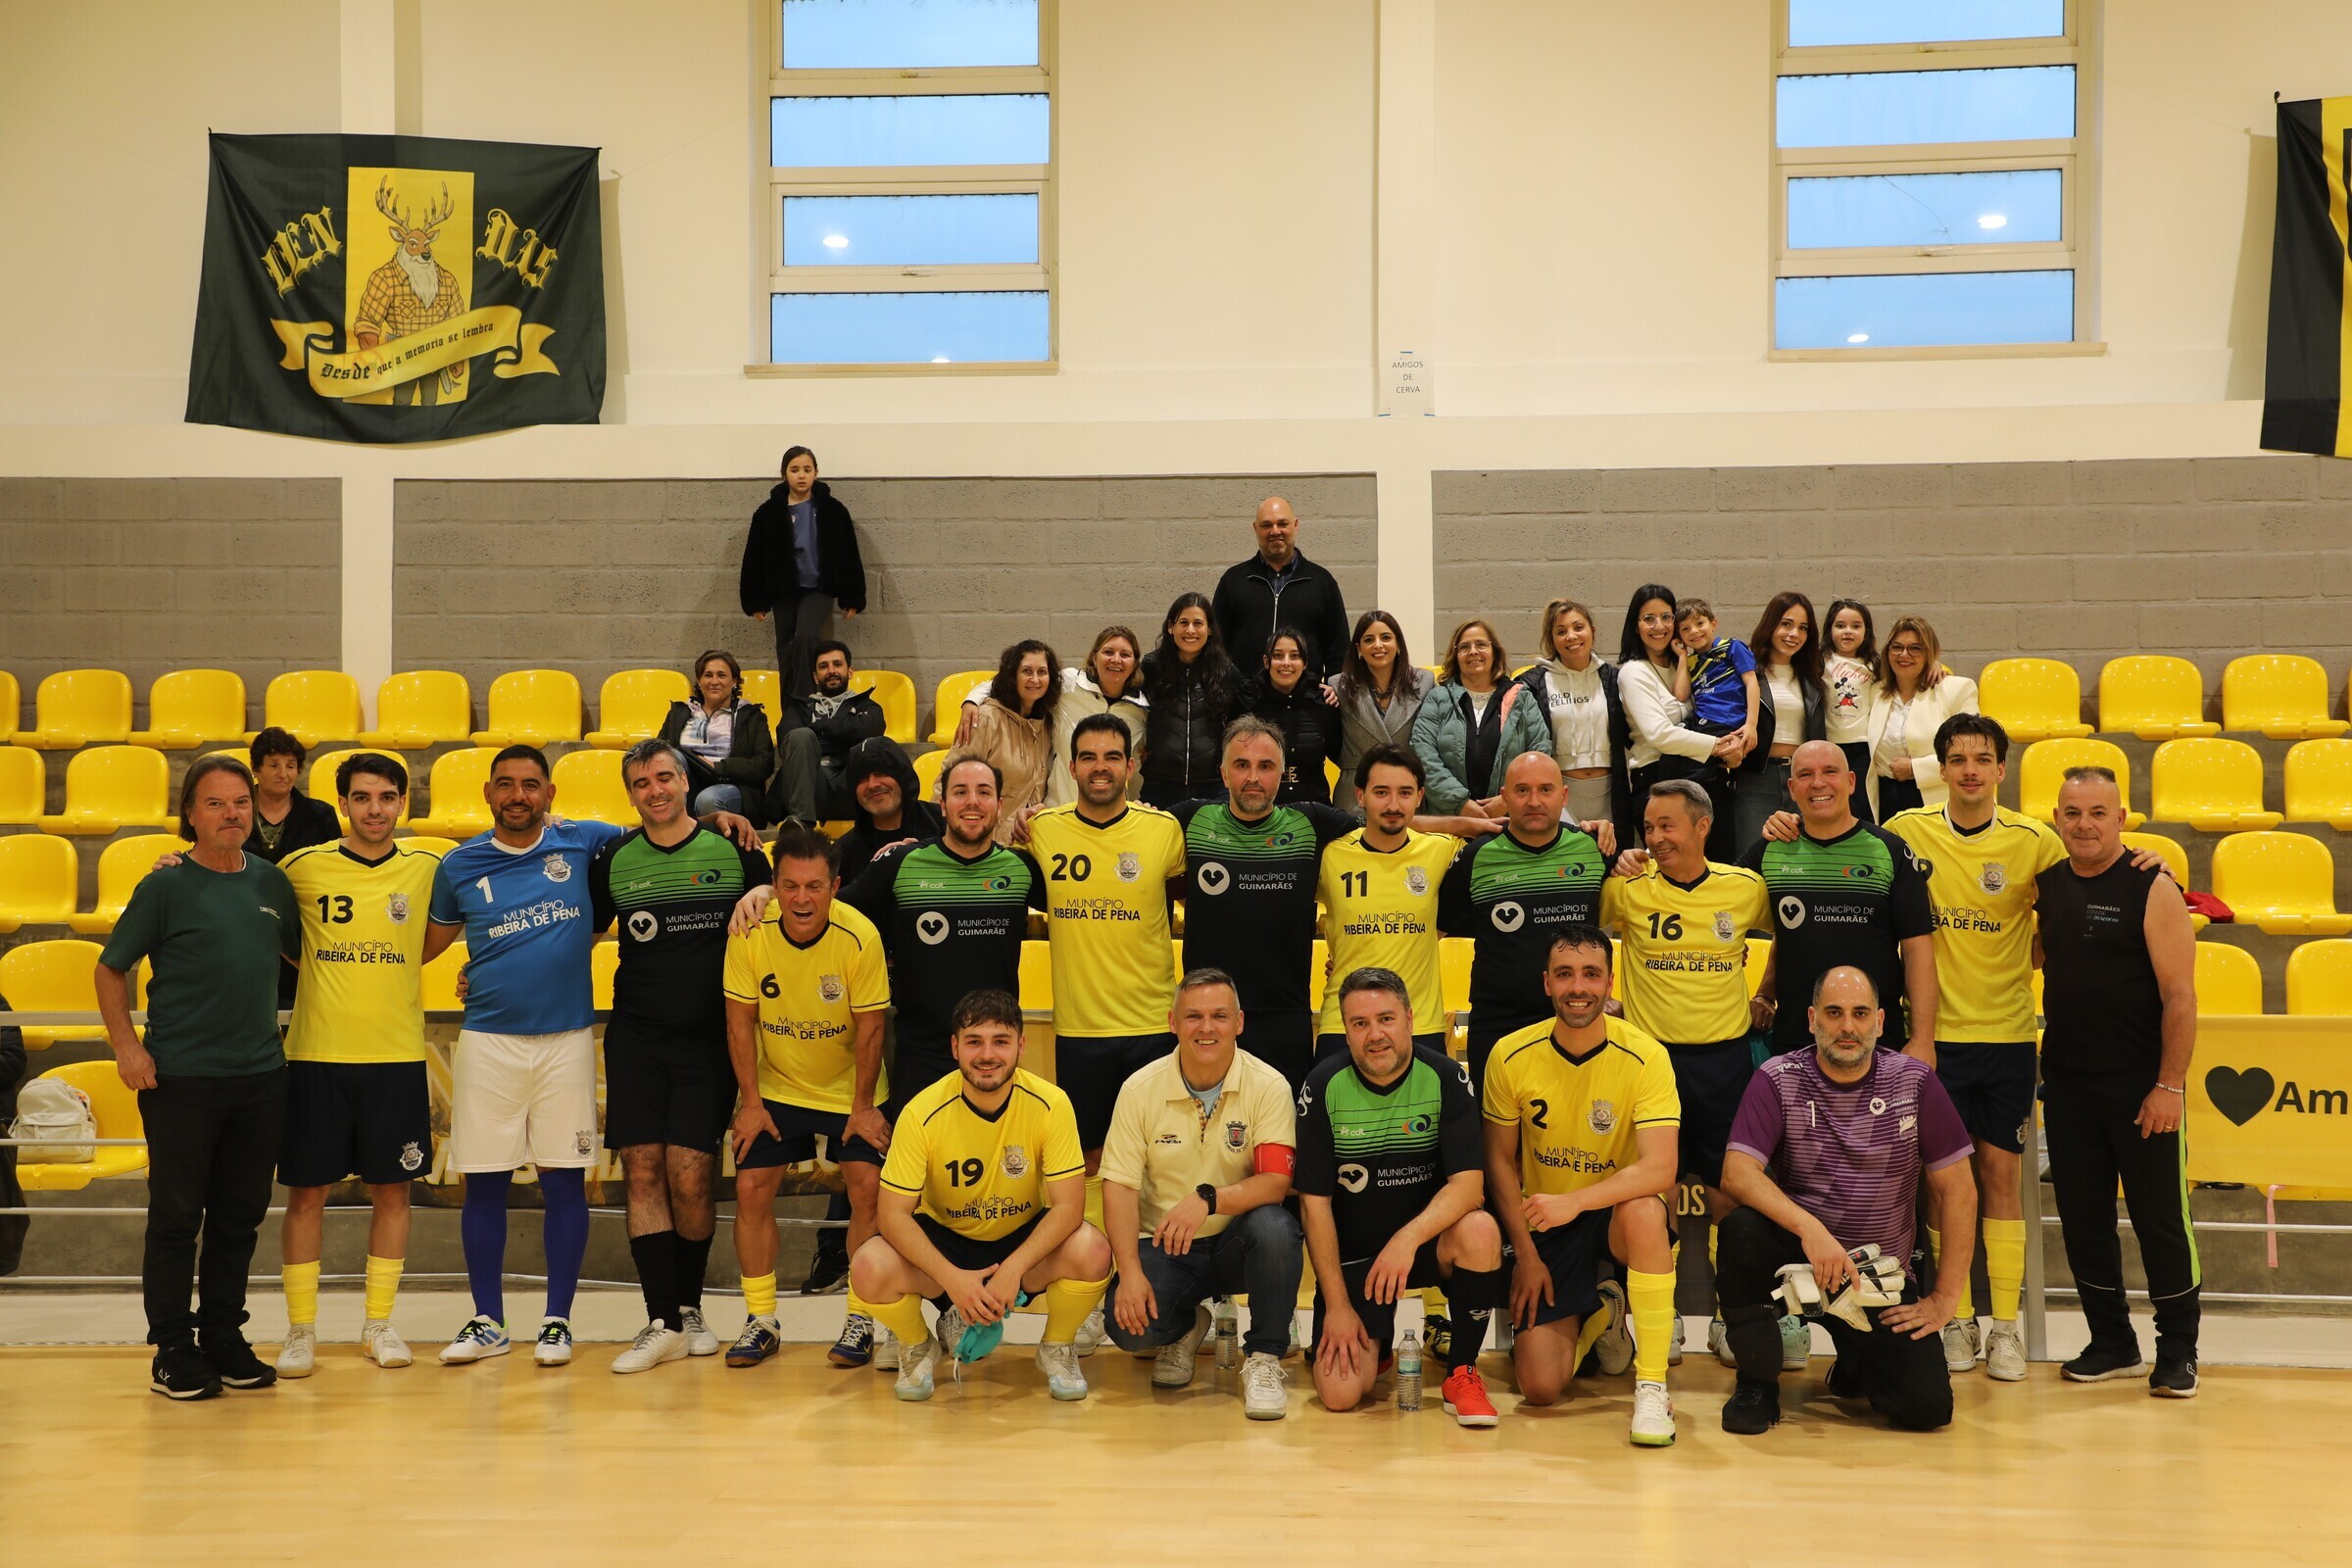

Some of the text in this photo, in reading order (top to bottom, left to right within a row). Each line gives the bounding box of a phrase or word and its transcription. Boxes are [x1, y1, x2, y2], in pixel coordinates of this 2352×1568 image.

[320, 322, 493, 380] Desde que a memoria se lembra
[1051, 853, 1091, 882] 20
[1239, 872, 1285, 882] MUNICÍPIO
[476, 876, 493, 904] 1
[1340, 871, 1368, 898] 11
[317, 895, 353, 924] 13
[1067, 897, 1124, 909] MUNICÍPIO
[1533, 904, 1579, 915] MUNICÍPIO
[1814, 904, 1874, 915] MUNICÍPIO DE
[503, 900, 564, 923] MUNICÍPIO
[666, 912, 712, 924] MUNICÍPIO
[1054, 907, 1140, 921] RIBEIRA DE PENA
[1358, 911, 1415, 923] MUNICÍPIO
[1932, 905, 1986, 920] MUNICÍPIO
[489, 906, 580, 938] RIBEIRA DE PENA
[958, 918, 1001, 927] MUNICÍPIO
[1534, 914, 1585, 924] GUIMARÃES
[1814, 915, 1868, 923] GUIMARÃES
[1954, 918, 1969, 930] DE
[1973, 920, 2001, 932] PENA
[667, 922, 719, 932] GUIMARÃES
[1344, 923, 1425, 935] RIBEIRA DE PENA
[1647, 912, 1683, 941] 16
[333, 939, 393, 952] MUNICÍPIO
[316, 949, 405, 964] RIBEIRA DE PENA
[1662, 951, 1721, 961] MUNICÍPIO
[1645, 959, 1732, 972] RIBEIRA DE PENA
[760, 973, 781, 999] 6
[778, 1016, 831, 1030] MNICÍPIO
[800, 1030, 815, 1039] DE
[819, 1024, 847, 1039] PENA
[2274, 1081, 2348, 1115] Am
[1530, 1099, 1548, 1129] 2
[1807, 1100, 1815, 1127] 1
[945, 1158, 984, 1187] 19
[1377, 1166, 1426, 1177] MUNICÍPIO
[1585, 1159, 1616, 1173] PENA
[1377, 1172, 1433, 1187] GUIMARÃES
[985, 1207, 998, 1220] DE
[1002, 1201, 1031, 1218] PENA
